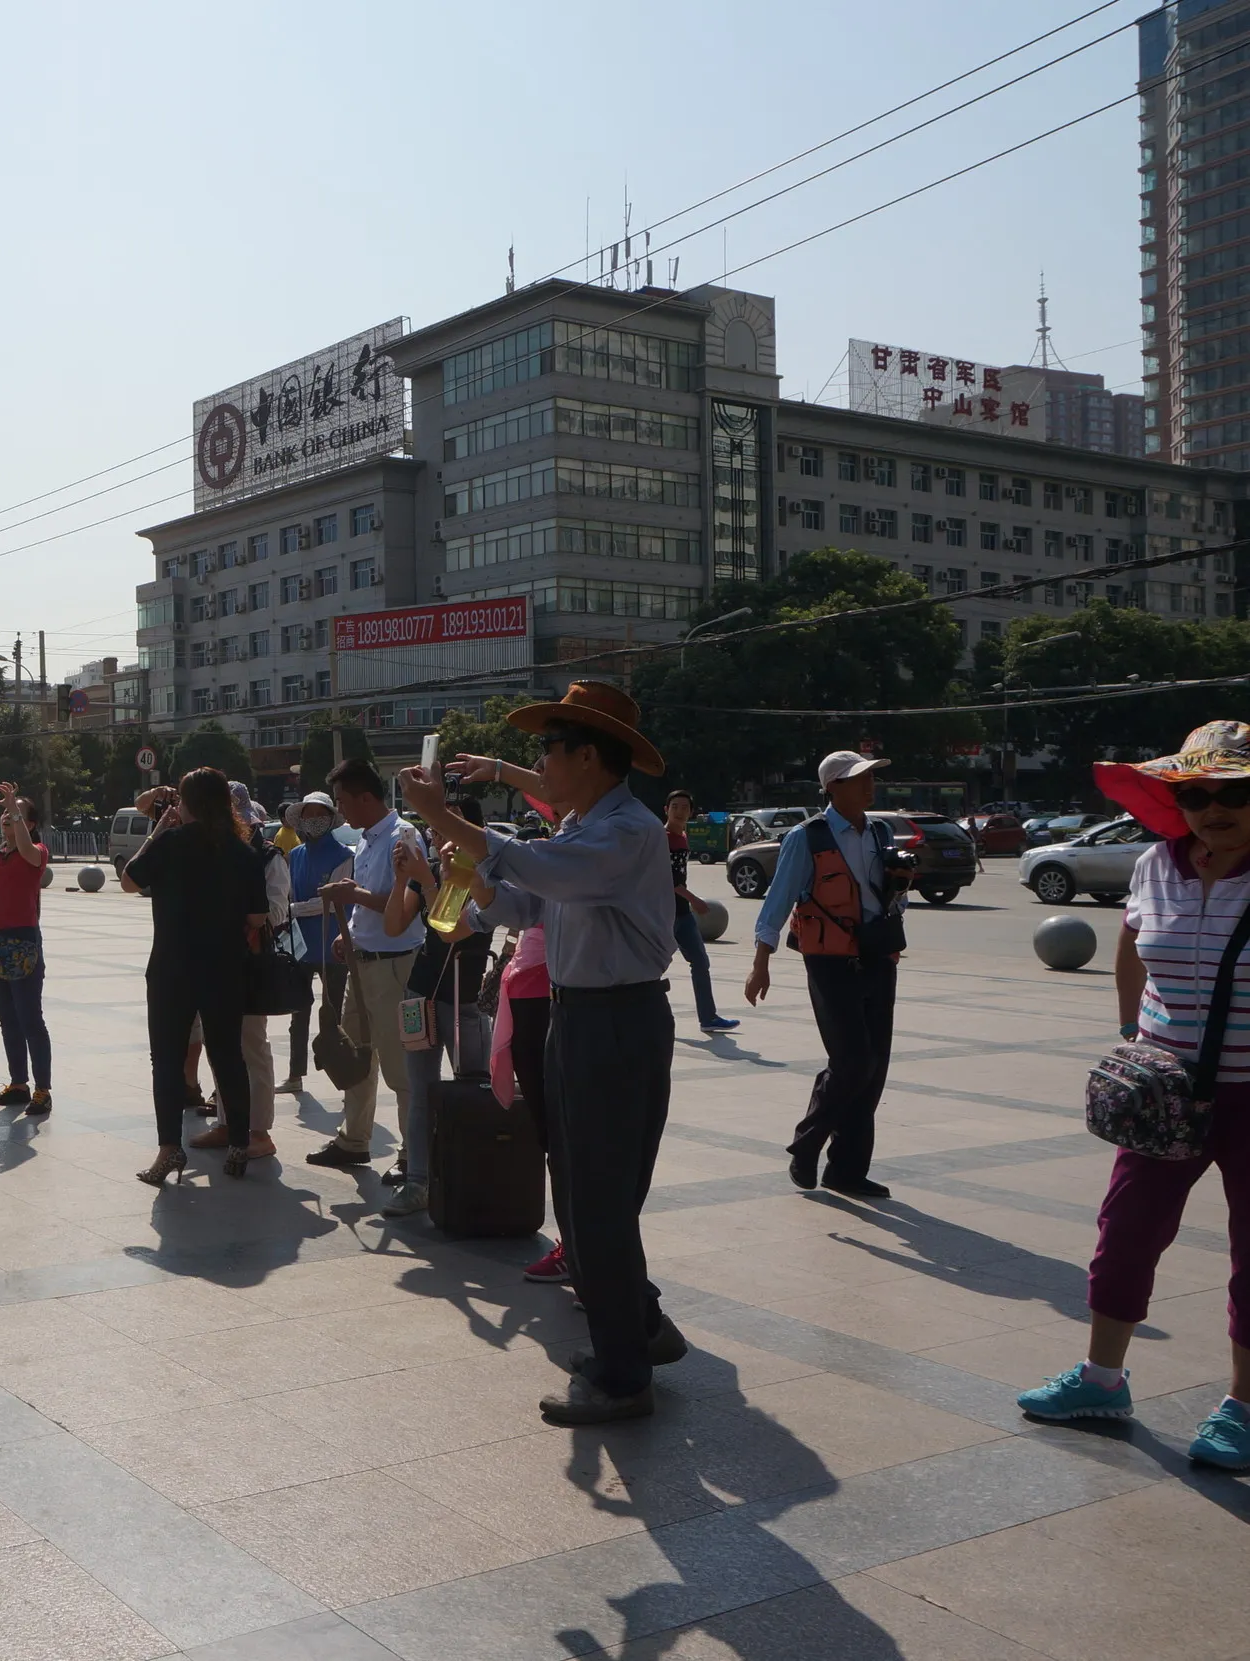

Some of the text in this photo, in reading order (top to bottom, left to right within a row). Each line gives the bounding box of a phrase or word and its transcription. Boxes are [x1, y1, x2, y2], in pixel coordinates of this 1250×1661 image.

[871, 345, 1002, 392] 甘肃省军区
[251, 343, 390, 446] 中国银行
[923, 386, 1031, 427] 中山宾馆
[253, 414, 390, 476] BANK OF CHINA
[337, 620, 355, 634] 广告
[357, 614, 435, 645] 18919810777
[441, 605, 525, 637] 18919310121
[337, 635, 355, 649] 招商
[140, 752, 153, 765] 40
